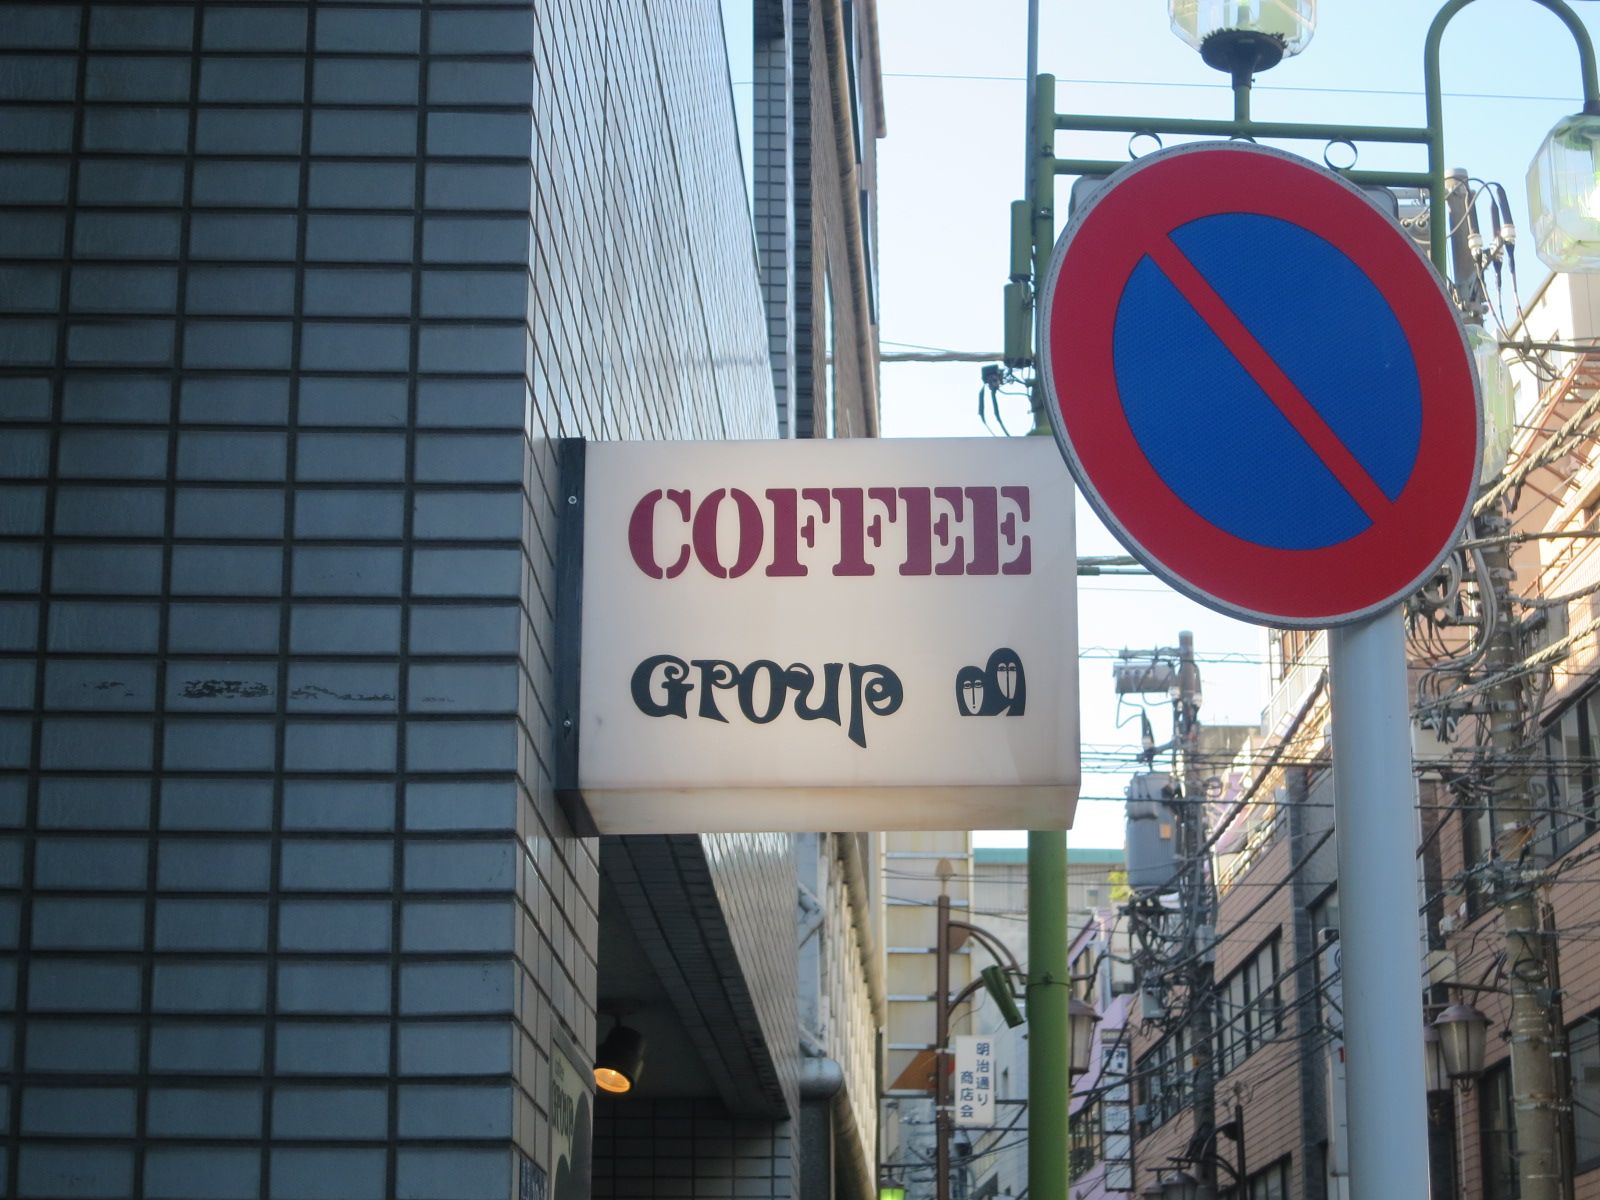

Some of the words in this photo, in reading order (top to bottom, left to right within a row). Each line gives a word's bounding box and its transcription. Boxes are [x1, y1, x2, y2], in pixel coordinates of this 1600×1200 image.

[628, 486, 1031, 579] COFFEE
[960, 1071, 973, 1118] 商店会
[976, 1043, 990, 1106] 明治通り
